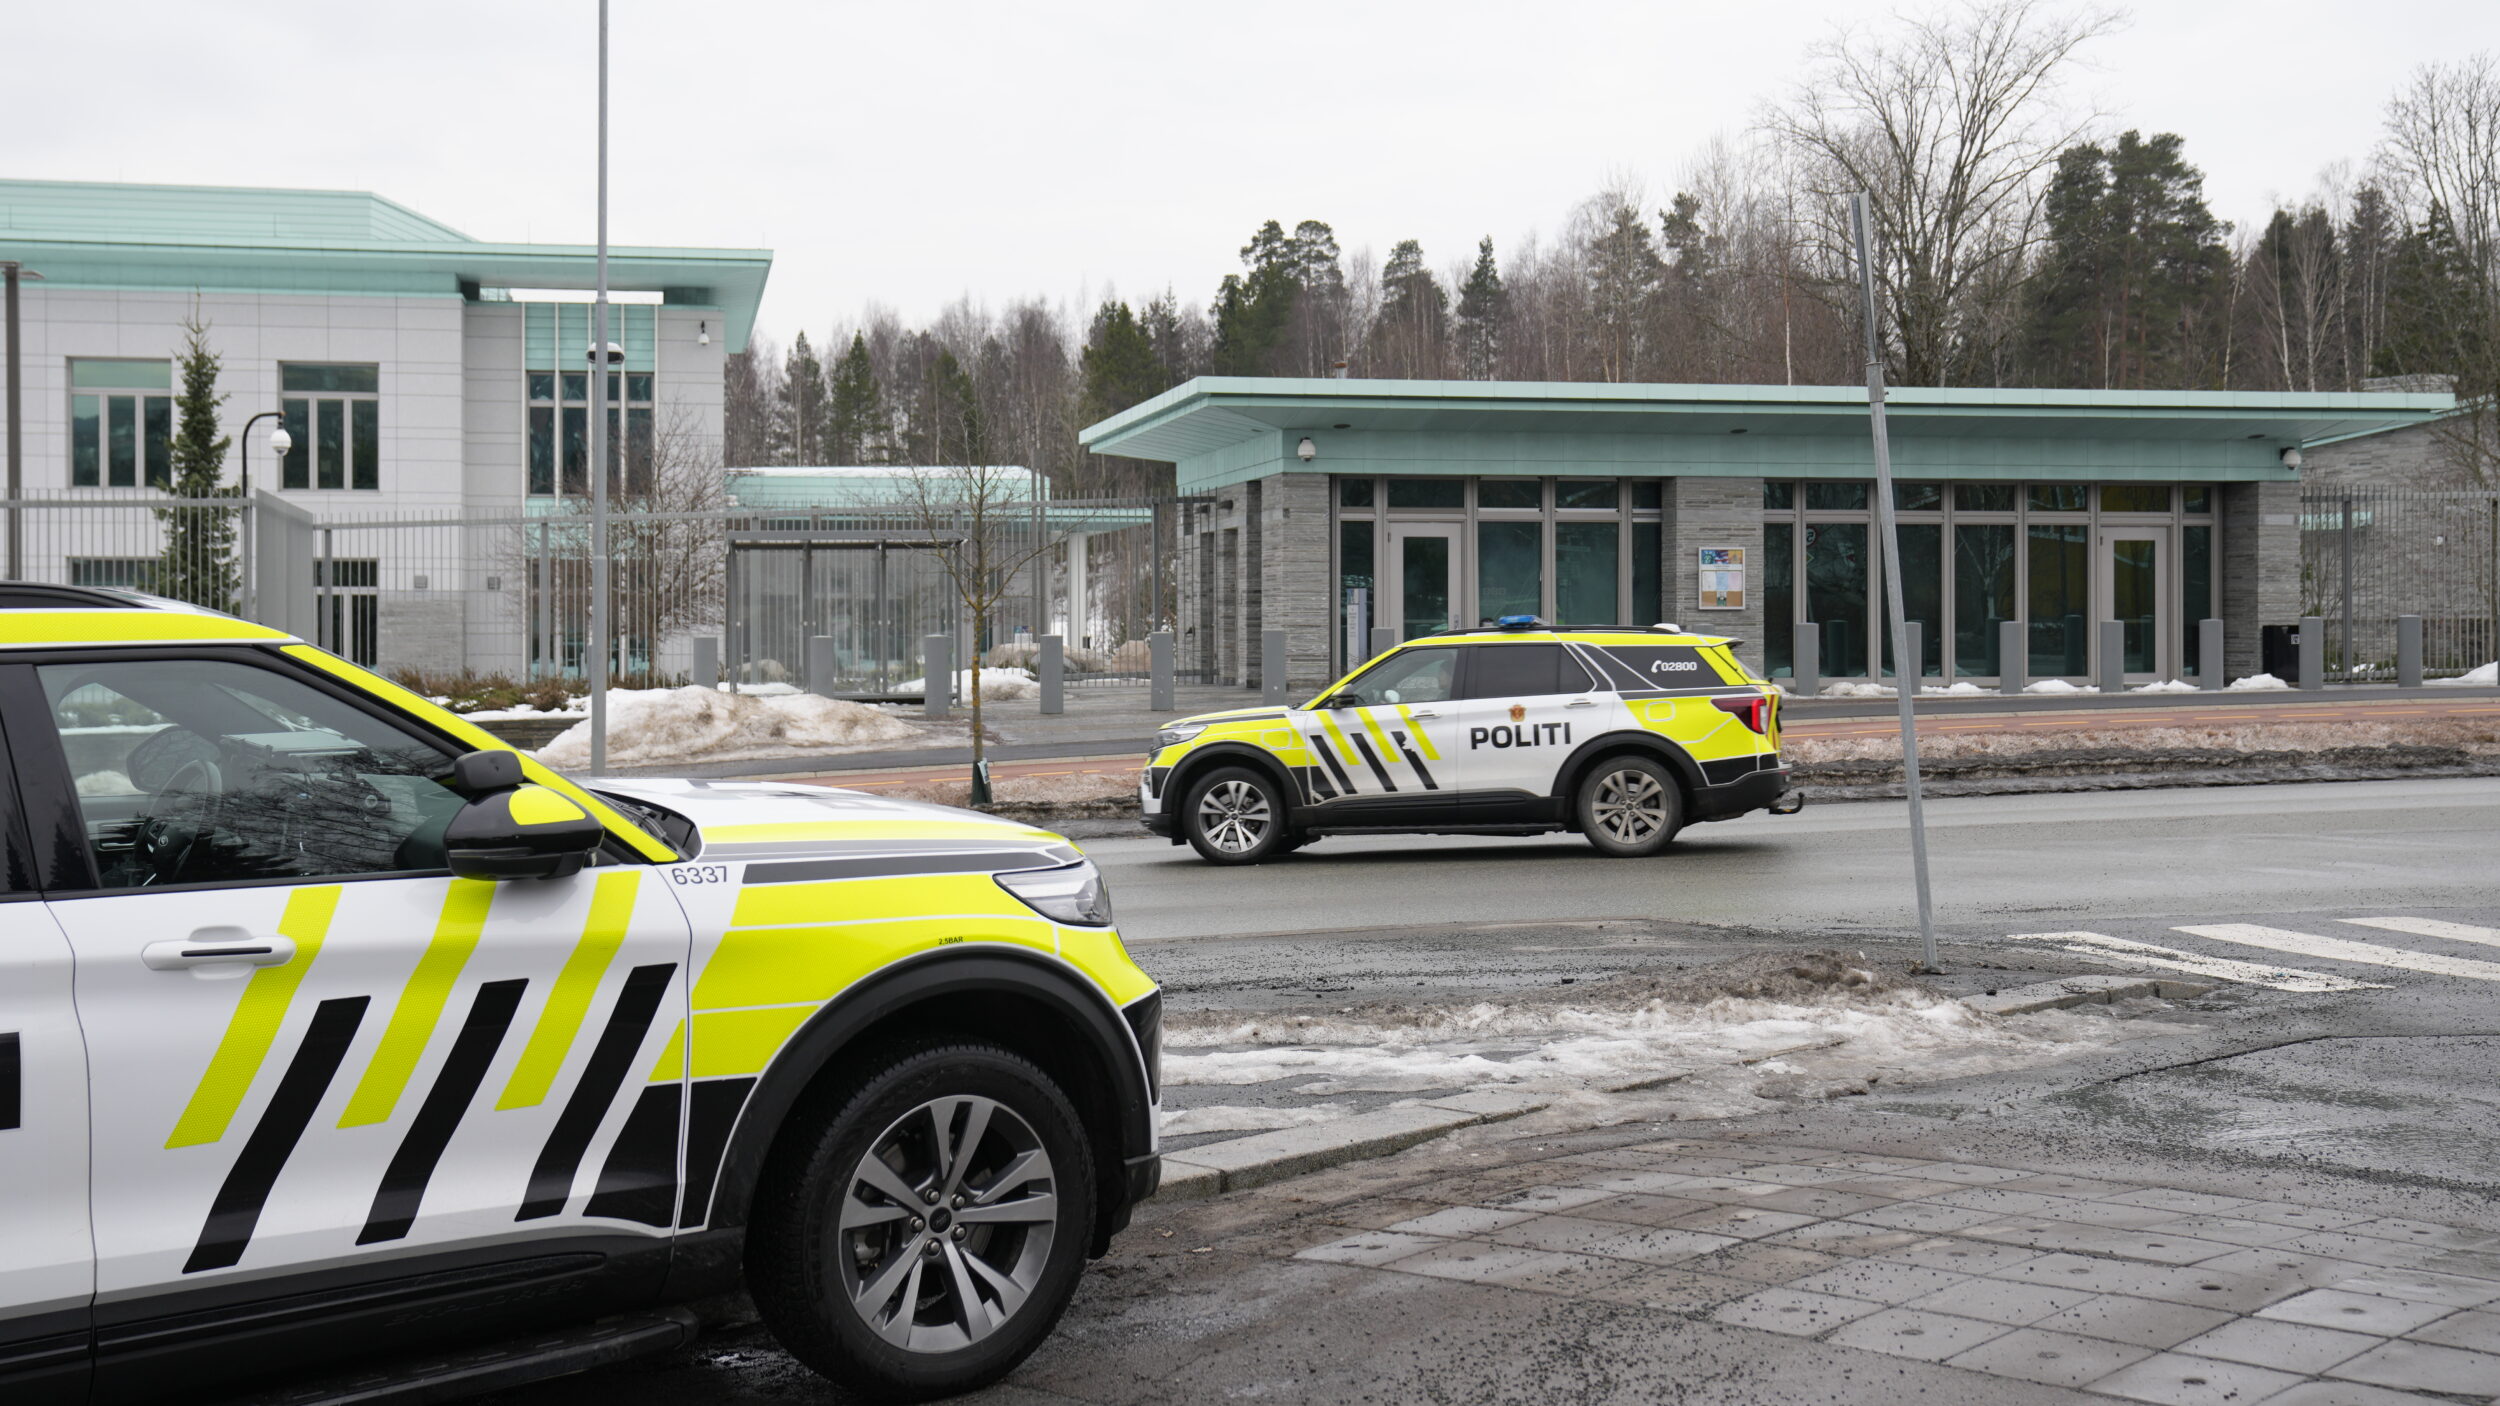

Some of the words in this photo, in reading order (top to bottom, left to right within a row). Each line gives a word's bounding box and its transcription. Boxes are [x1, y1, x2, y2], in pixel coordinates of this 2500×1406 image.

[1660, 661, 1698, 672] 02800
[1470, 722, 1570, 750] POLITI
[671, 865, 727, 885] 6337
